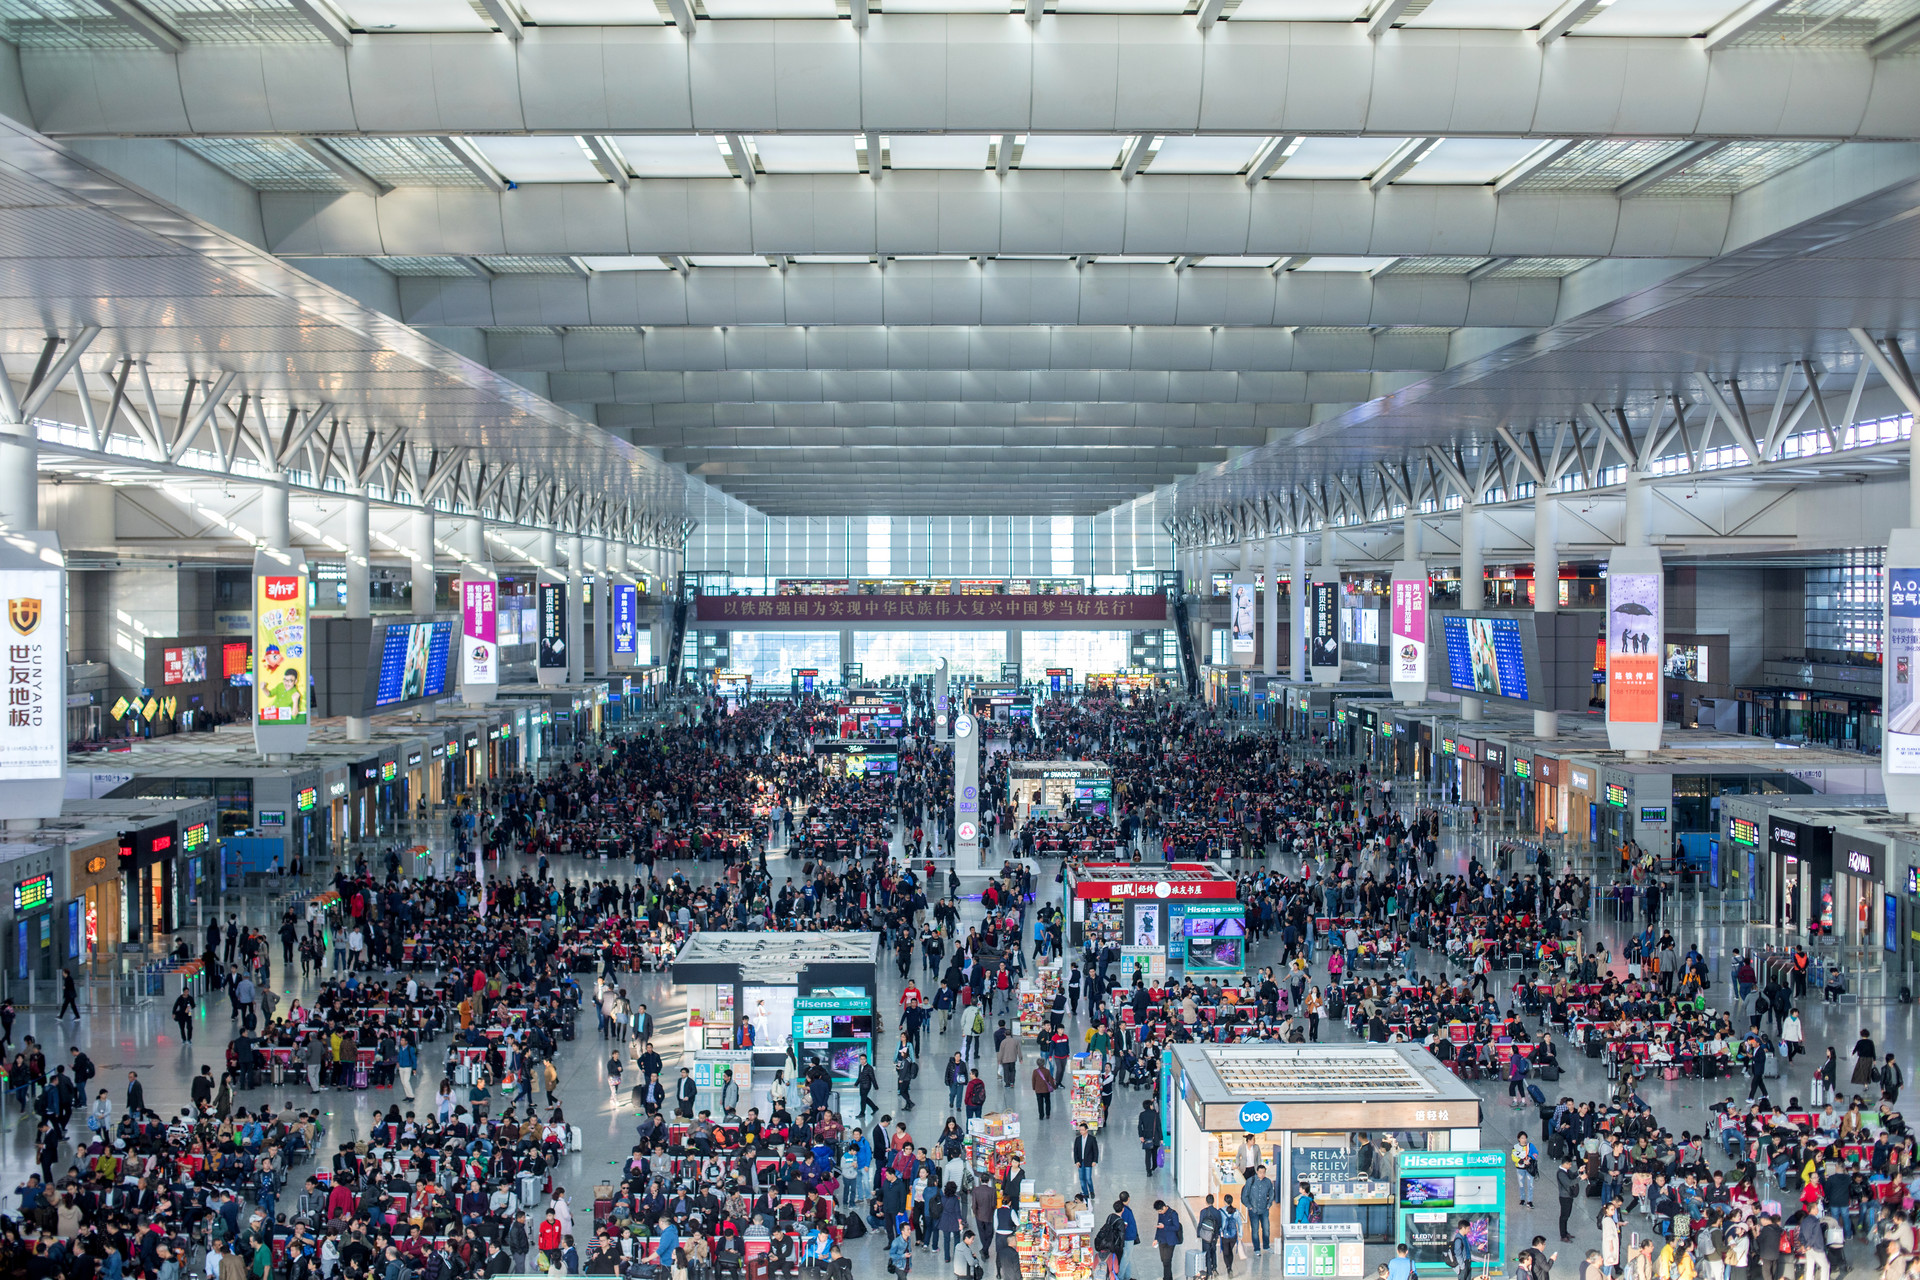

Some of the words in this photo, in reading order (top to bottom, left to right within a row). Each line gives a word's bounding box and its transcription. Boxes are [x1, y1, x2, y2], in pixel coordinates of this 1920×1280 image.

[1892, 592, 1920, 606] 空气
[1614, 671, 1654, 681] 路铁传媒
[8, 644, 31, 727] 世友地板
[31, 644, 42, 727] SUNYARD
[1848, 850, 1871, 874] HONMA
[1187, 906, 1221, 914] Hisense
[796, 1000, 840, 1008] Hisense
[1241, 1112, 1269, 1123] breo
[1415, 1109, 1449, 1121] 倍轻松
[1310, 1150, 1347, 1160] RELAX
[1310, 1161, 1348, 1171] RELIEV
[1404, 1156, 1464, 1167] Hisense
